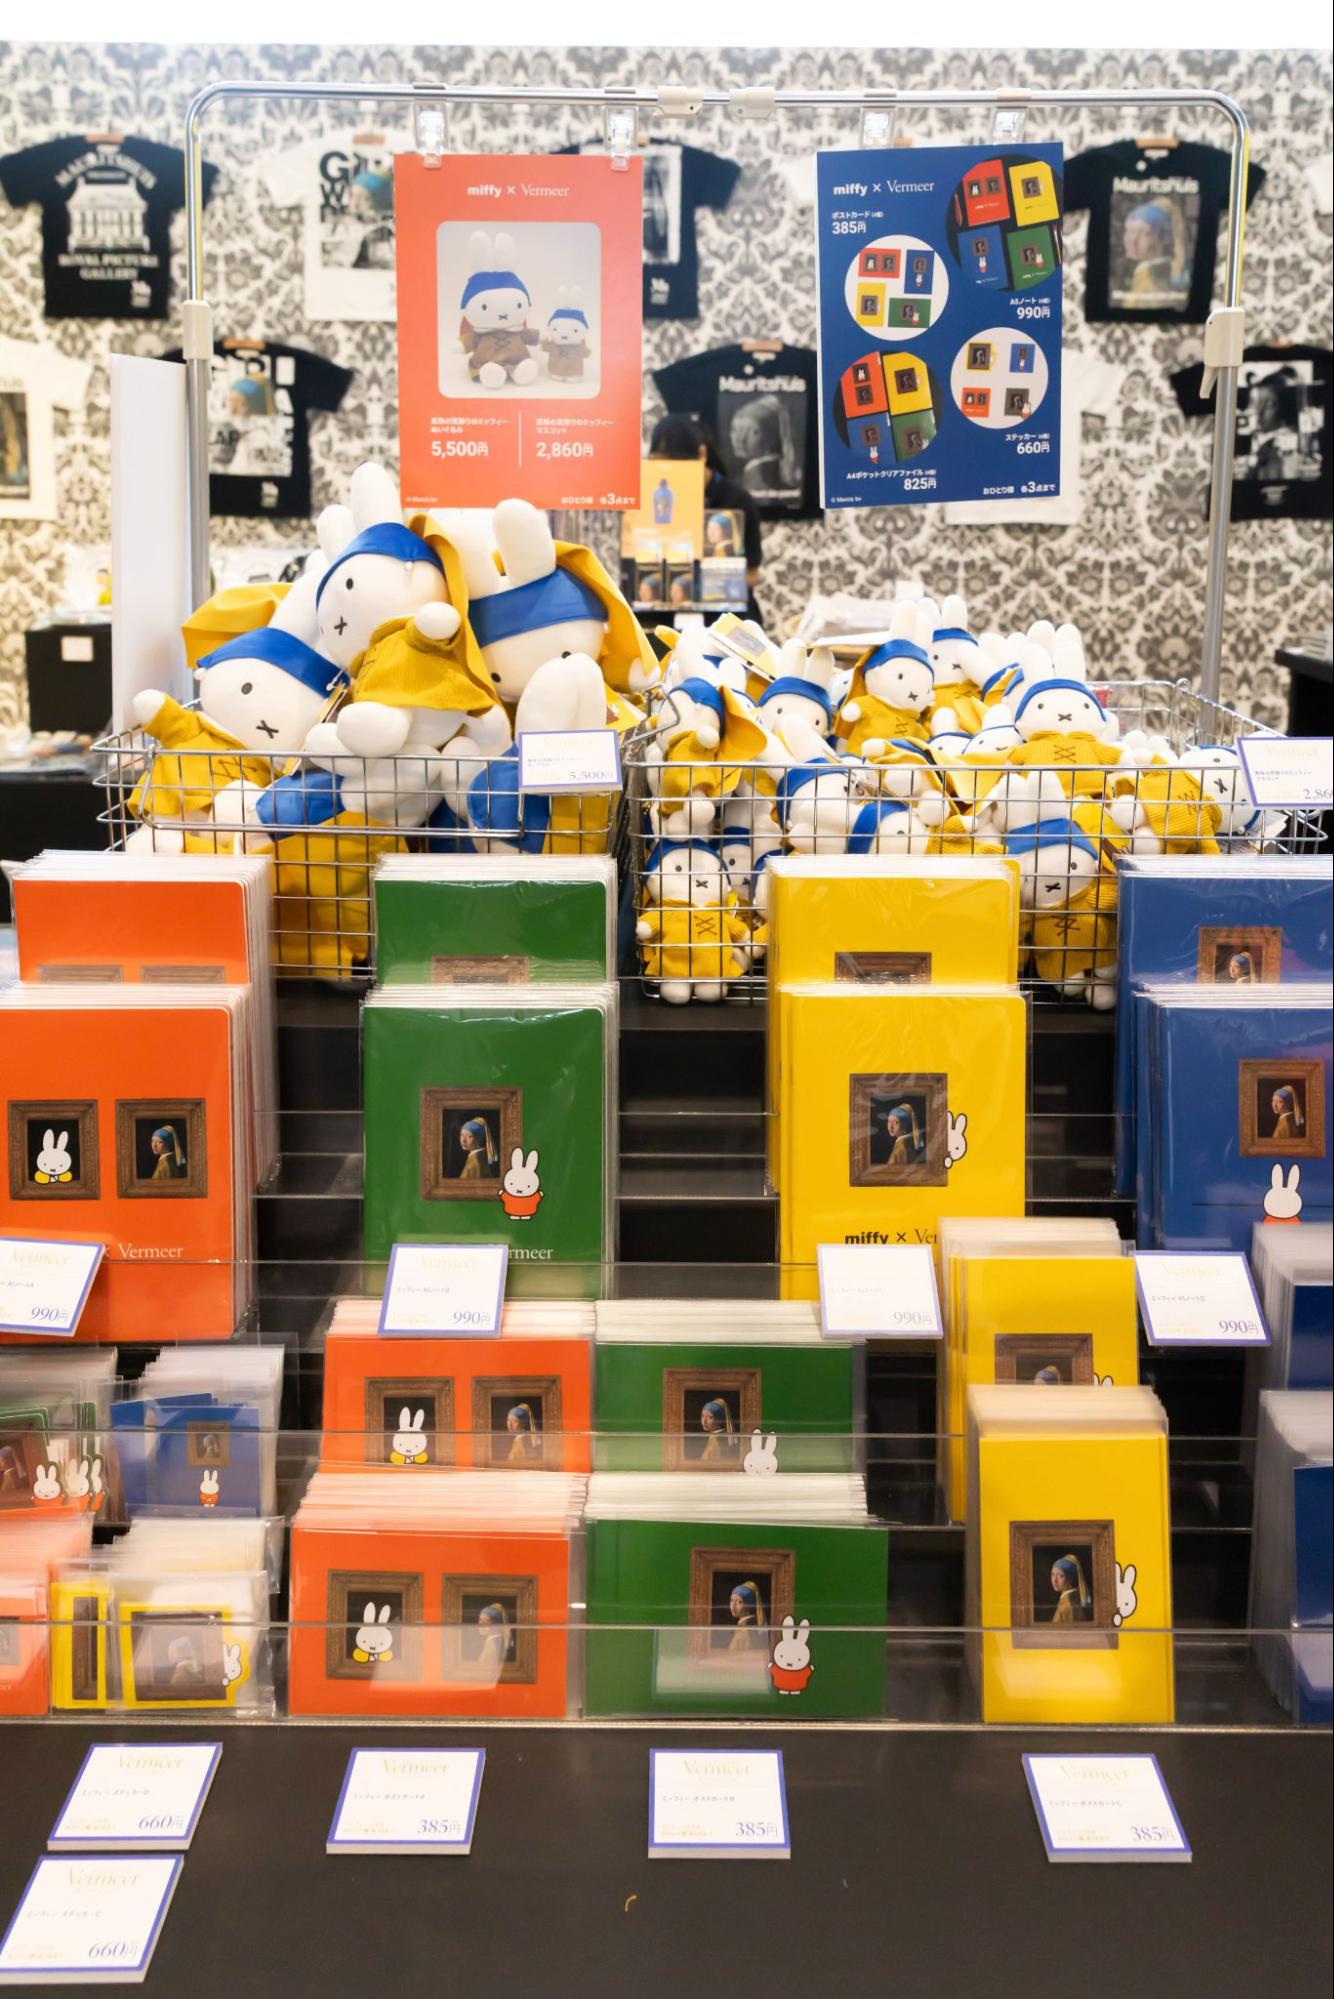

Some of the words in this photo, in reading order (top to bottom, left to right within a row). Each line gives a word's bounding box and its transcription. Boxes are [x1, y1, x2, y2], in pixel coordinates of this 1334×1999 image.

[467, 184, 502, 198] miffy
[521, 183, 569, 196] Vermeer
[833, 183, 868, 197] miffy
[886, 179, 935, 193] Vermeer
[832, 220, 867, 235] 385円
[1016, 306, 1051, 320] 990円
[431, 440, 489, 459] 5,500円
[536, 441, 594, 460] 2,860円
[1016, 441, 1050, 455] 660円
[903, 477, 937, 491] 825円
[1303, 788, 1333, 800] 2,86
[118, 1242, 184, 1259] Vermeer
